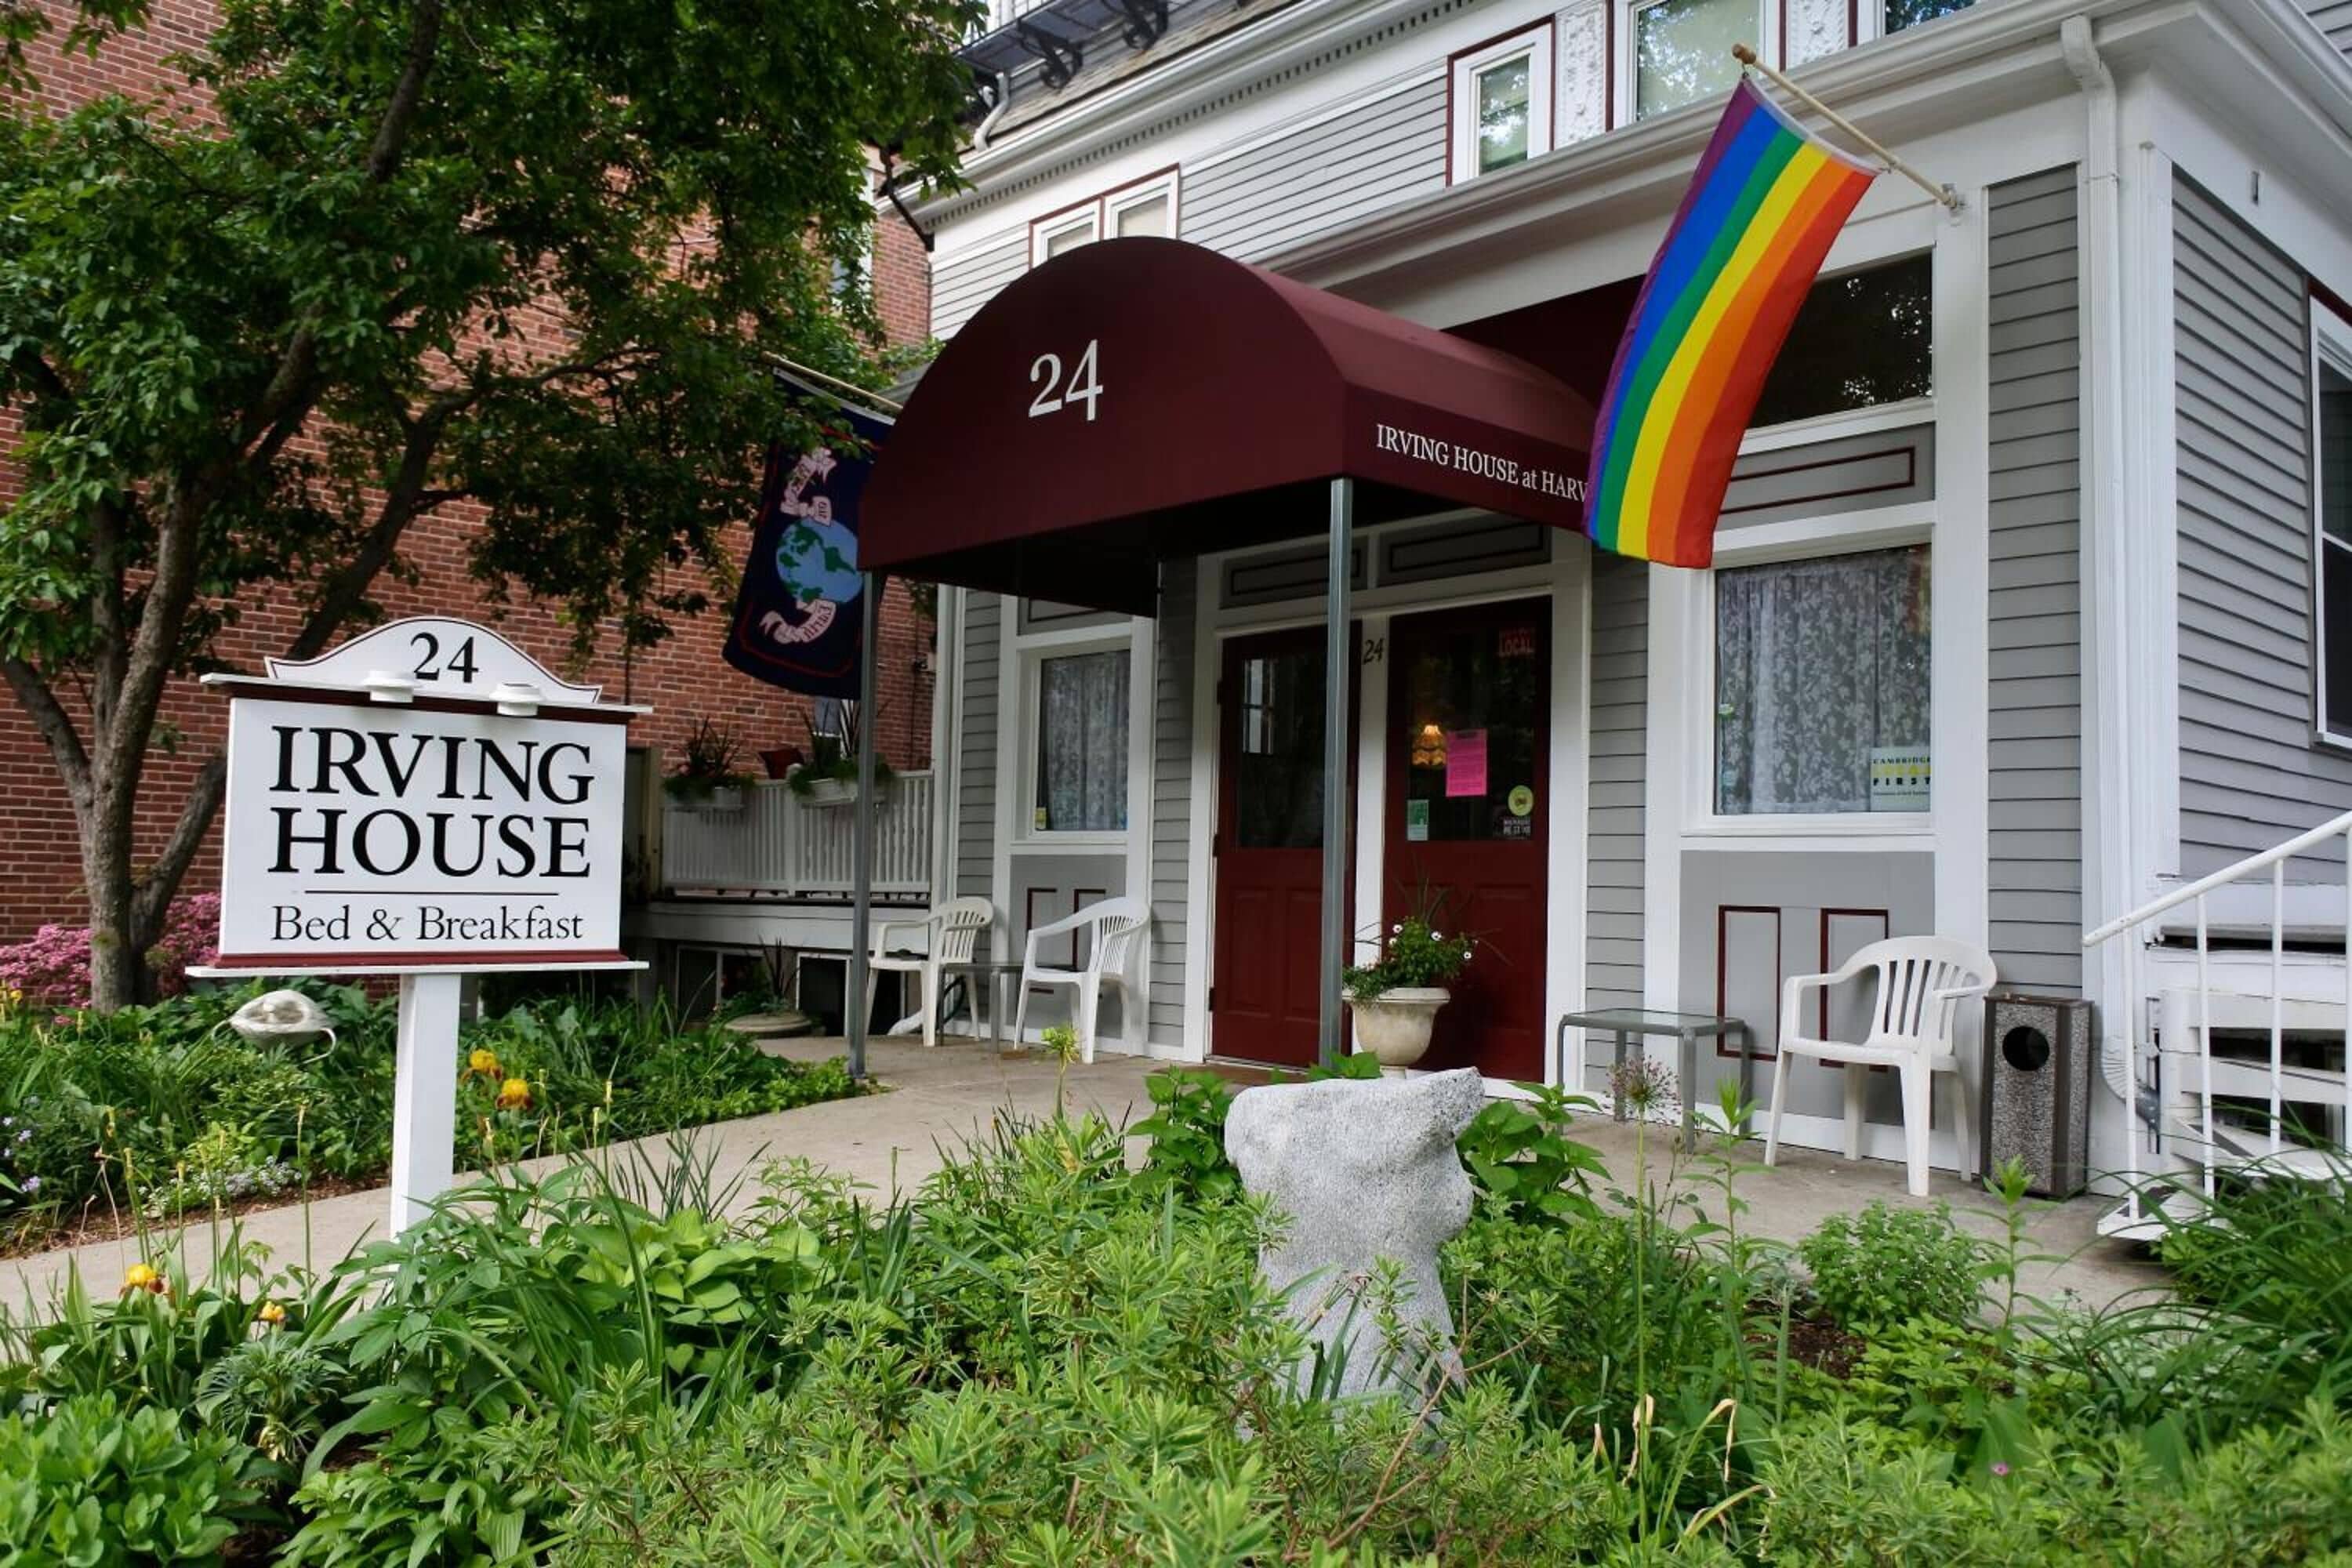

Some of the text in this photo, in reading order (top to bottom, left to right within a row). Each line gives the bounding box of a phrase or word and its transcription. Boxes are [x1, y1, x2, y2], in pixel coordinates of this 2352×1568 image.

[1027, 339, 1104, 421] 24
[1376, 423, 1449, 466] IRVING
[1454, 445, 1519, 485] HOUSE
[1523, 469, 1537, 490] at
[410, 631, 479, 684] 24
[1363, 638, 1385, 665] 24
[269, 725, 595, 805] IRVING
[1873, 777, 1930, 786] FIRST
[267, 807, 590, 878] HOUSE
[270, 905, 583, 942] Bed & Breakfast
